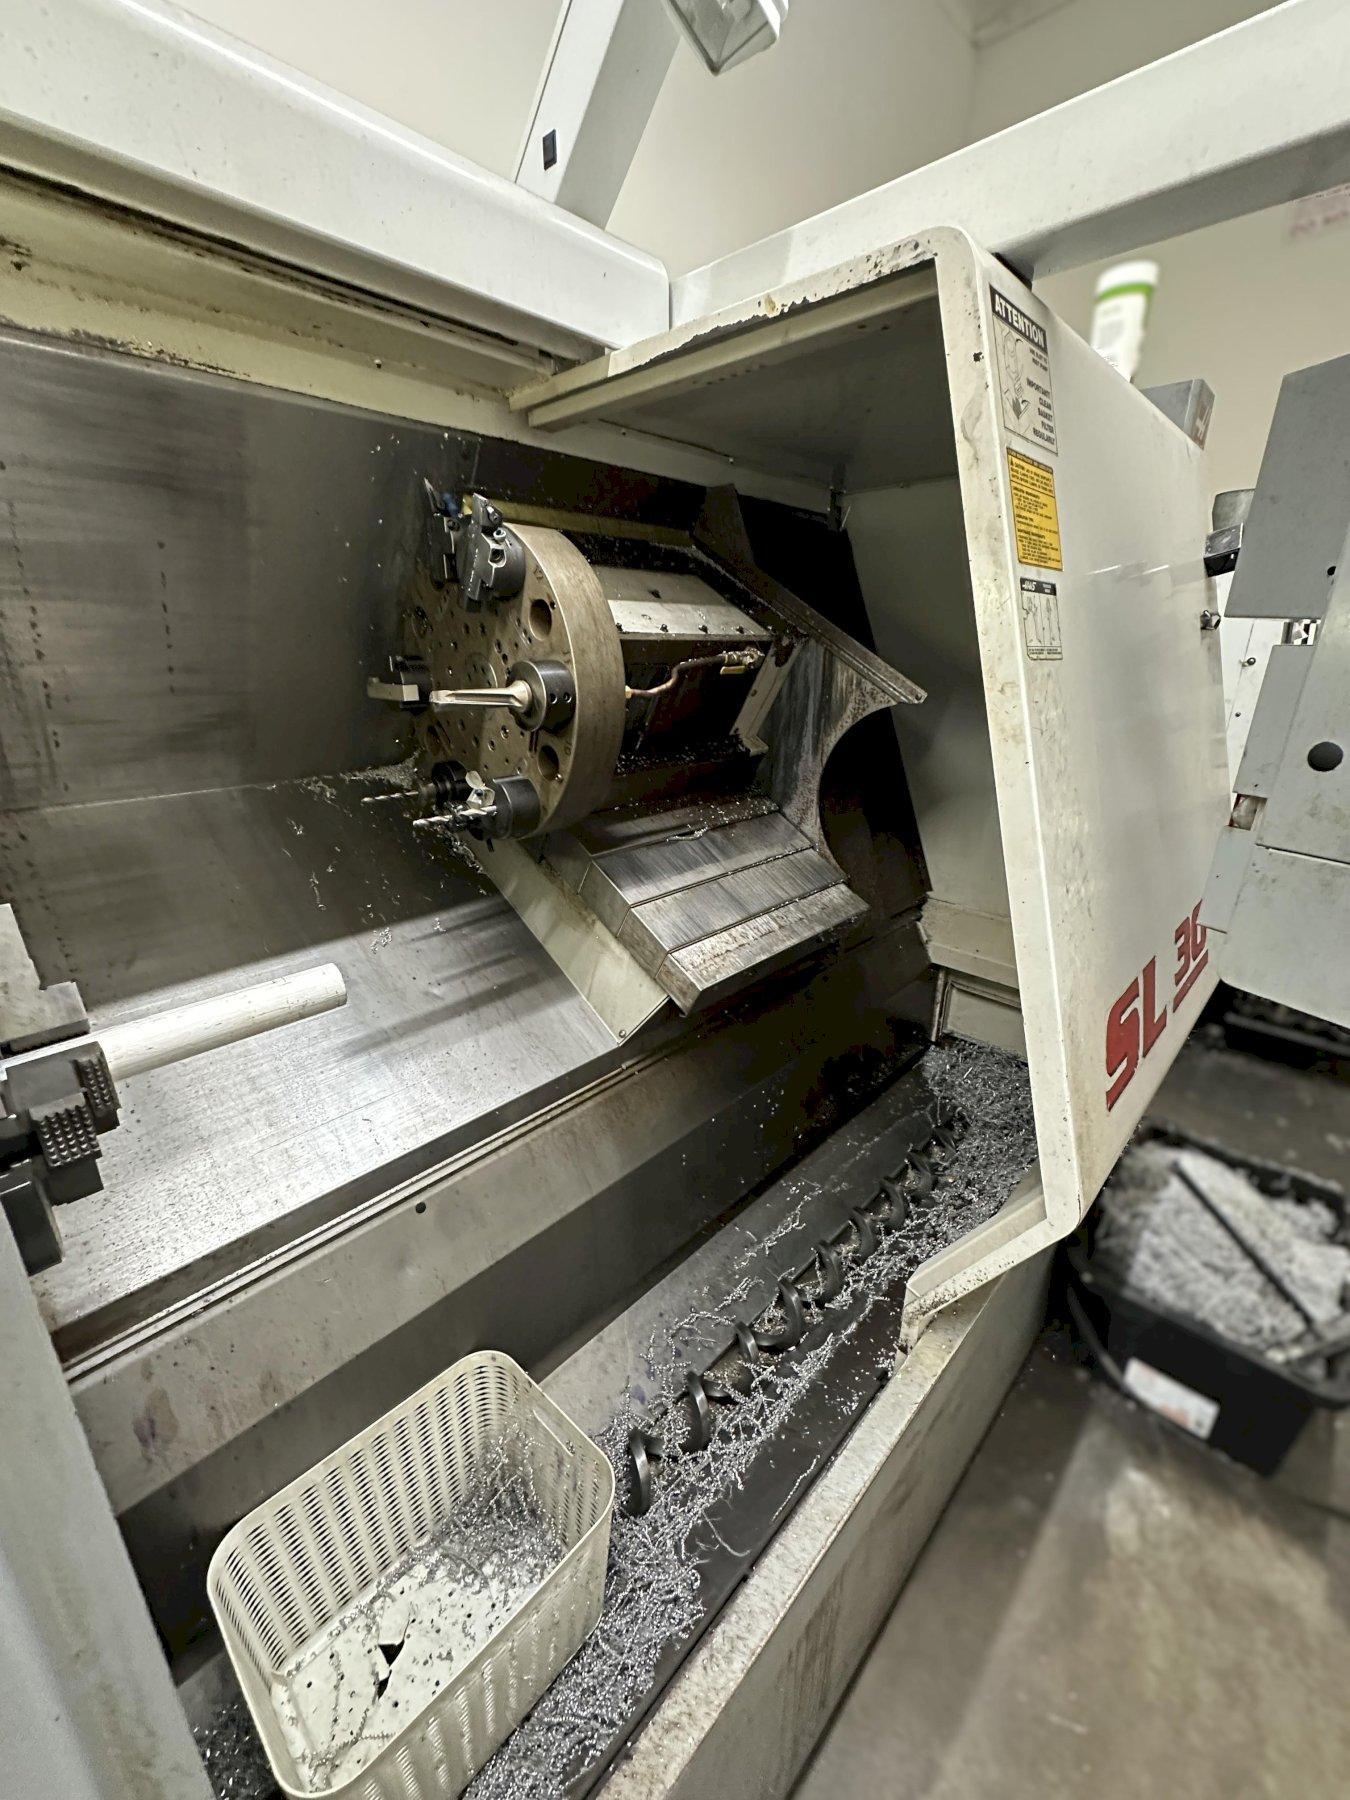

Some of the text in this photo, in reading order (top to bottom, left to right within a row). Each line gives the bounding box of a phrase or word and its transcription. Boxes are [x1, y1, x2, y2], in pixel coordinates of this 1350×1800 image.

[995, 294, 1045, 348] ATTENTION
[1039, 397, 1052, 411] CLEAN
[1041, 420, 1054, 435] FILTER
[1106, 955, 1167, 1113] SL
